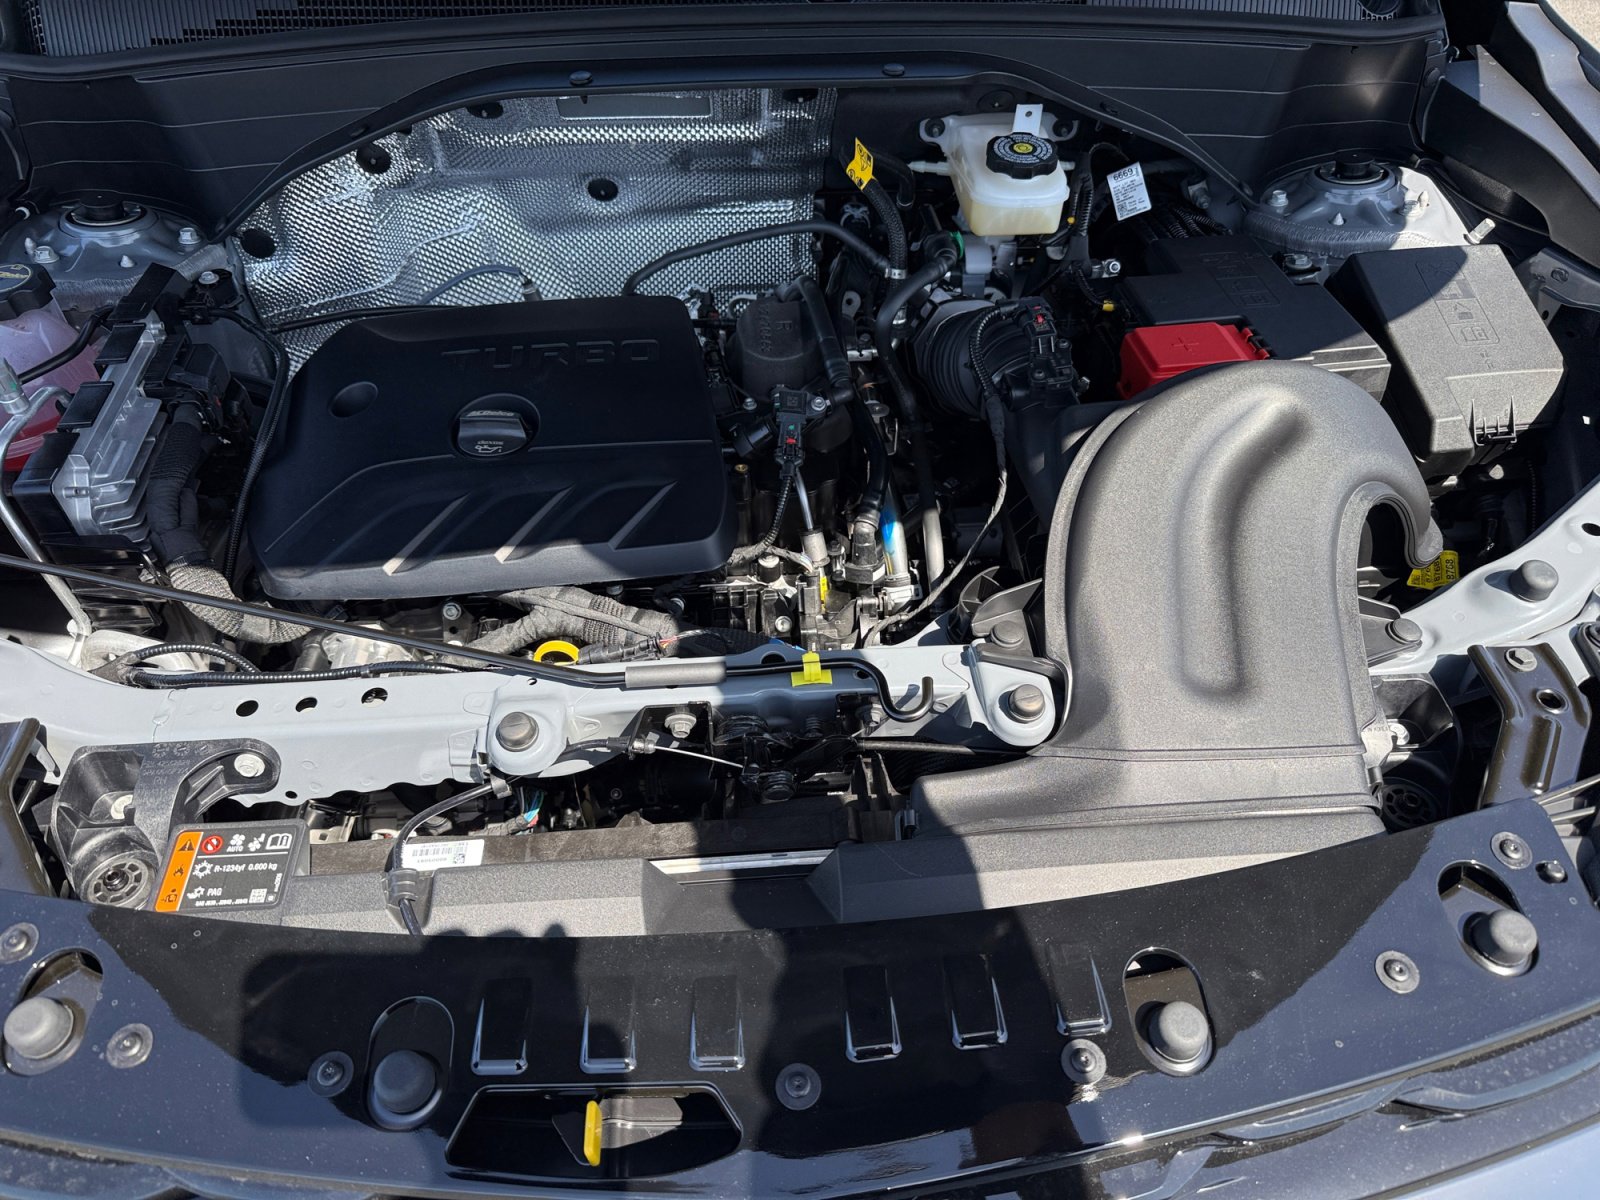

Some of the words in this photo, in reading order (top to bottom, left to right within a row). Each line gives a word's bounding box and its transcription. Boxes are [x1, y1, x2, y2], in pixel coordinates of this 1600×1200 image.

[1113, 168, 1134, 181] 6669
[441, 339, 659, 371] TURBO
[1445, 558, 1455, 580] 8768
[226, 845, 244, 853] AUTO
[213, 863, 246, 873] R-1234yf
[268, 862, 278, 871] kg
[206, 887, 223, 897] PAG
